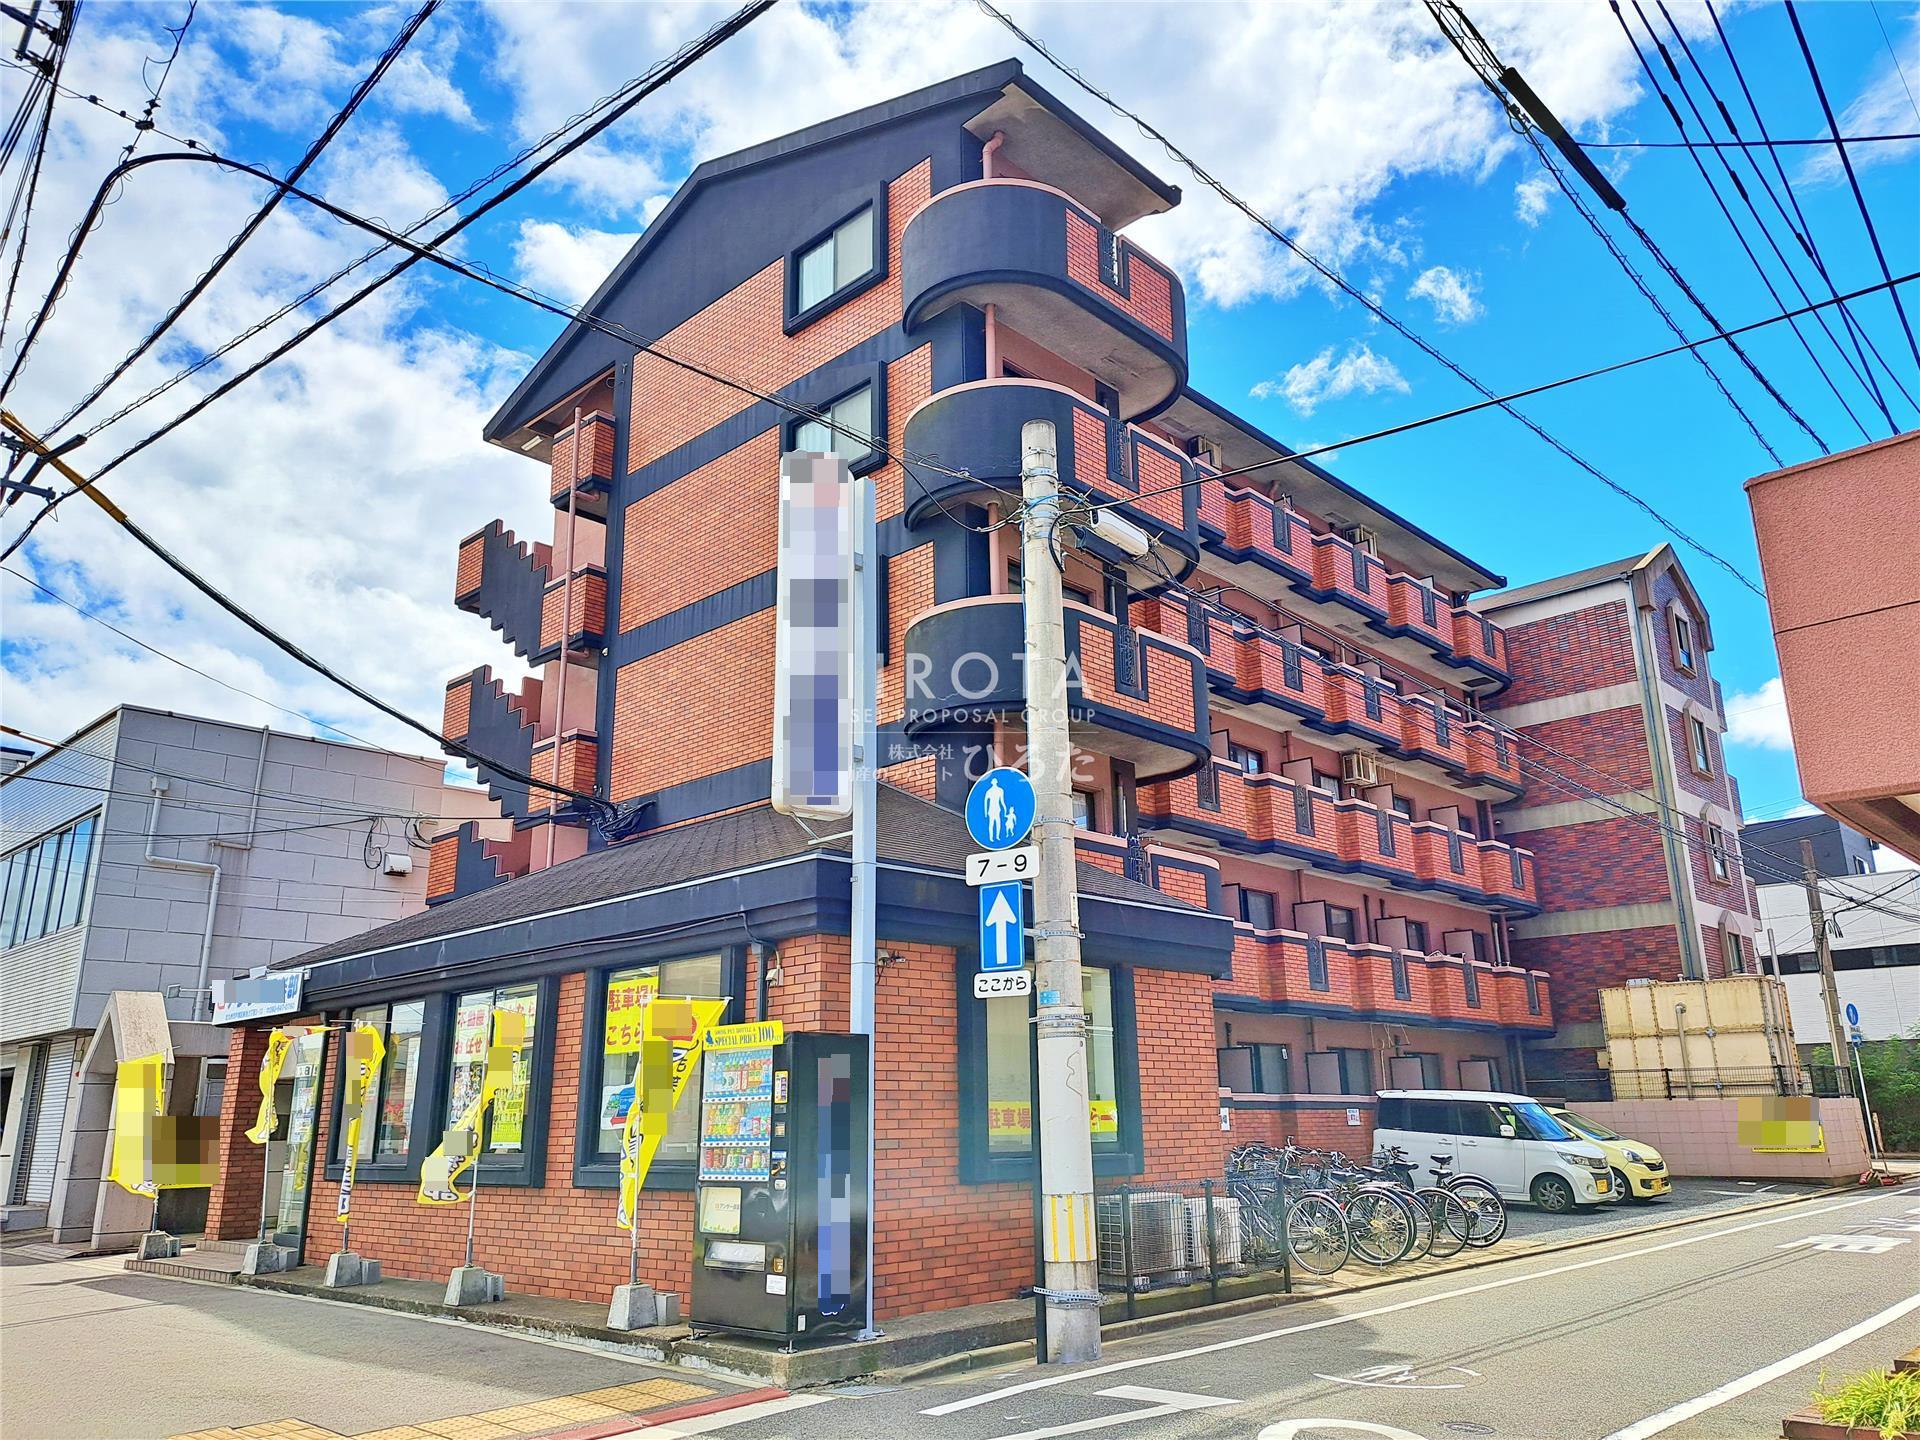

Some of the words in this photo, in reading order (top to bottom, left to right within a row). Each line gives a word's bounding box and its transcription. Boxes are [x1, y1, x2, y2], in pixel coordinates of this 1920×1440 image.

[977, 853, 1028, 878] 7-9
[977, 976, 1028, 993] ここから
[758, 1026, 774, 1042] 100
[988, 1107, 1031, 1129] 駐車場
